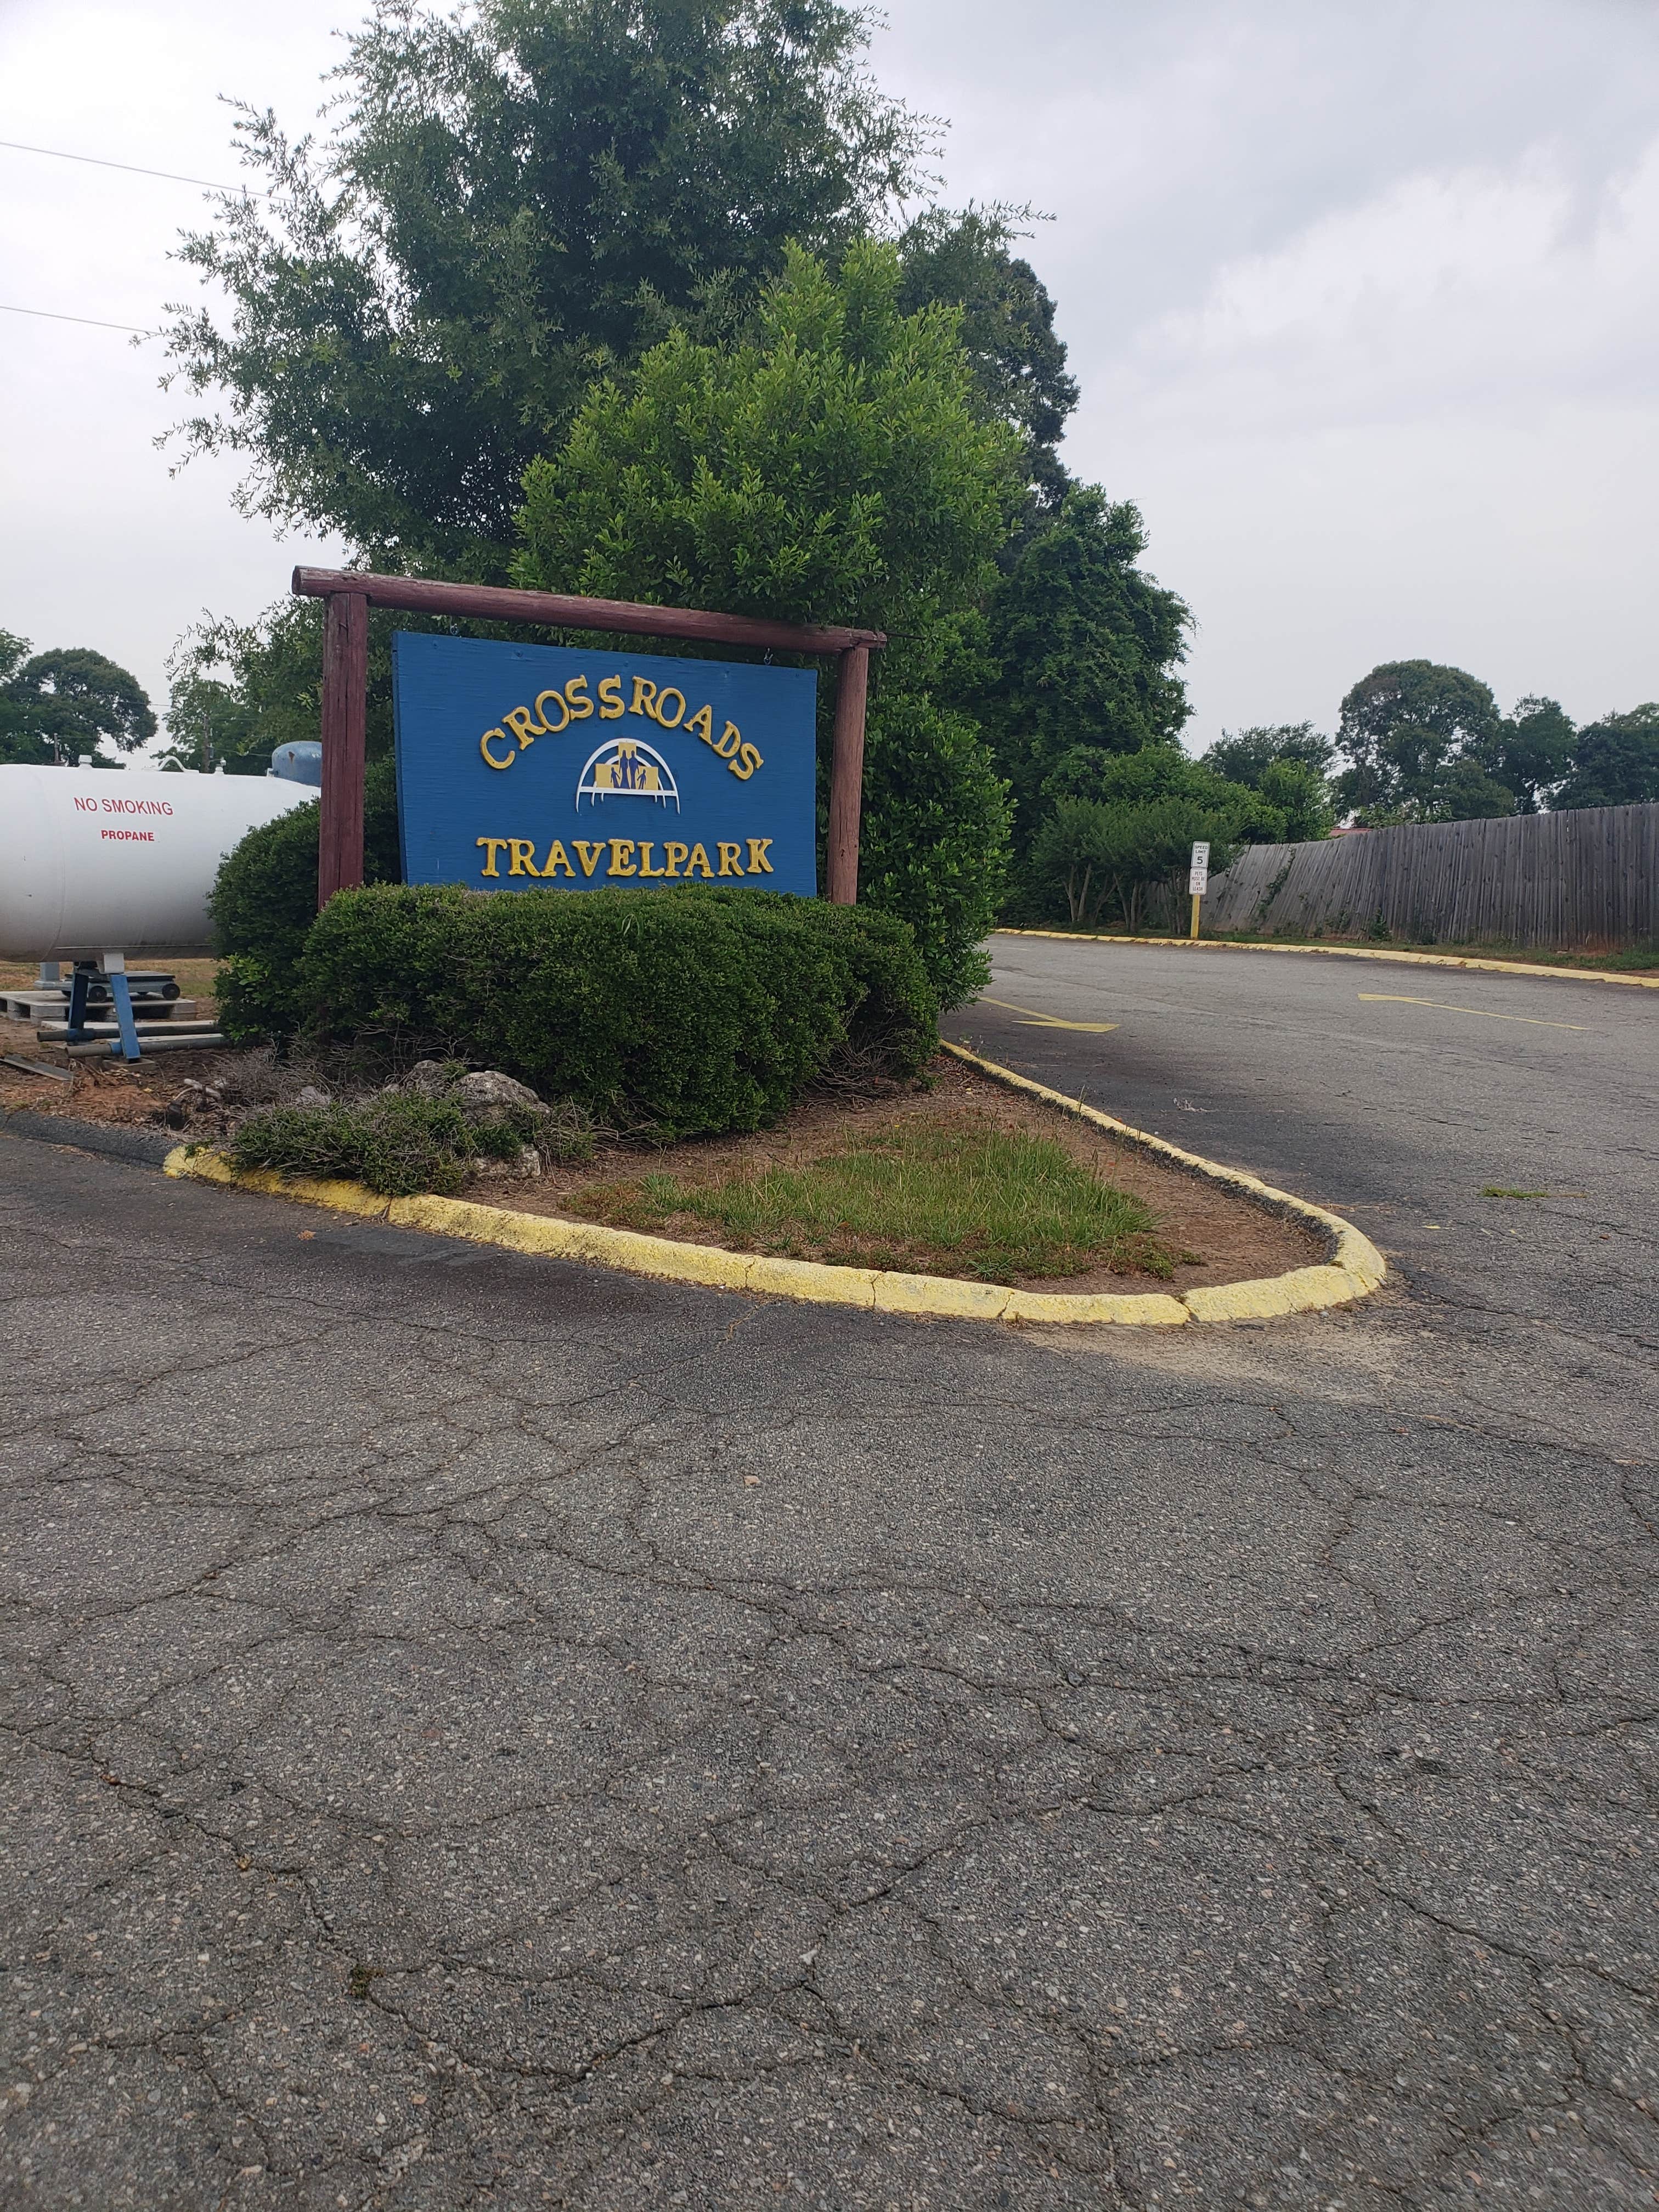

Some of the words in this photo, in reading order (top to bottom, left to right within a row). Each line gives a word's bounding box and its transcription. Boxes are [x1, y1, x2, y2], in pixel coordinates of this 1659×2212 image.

[479, 674, 764, 781] CROSSROADS
[74, 797, 98, 811] NO
[101, 799, 173, 815] SMOKING
[101, 830, 155, 842] PROPANE
[476, 837, 774, 878] TRAVELPARK
[1197, 856, 1203, 864] 5
